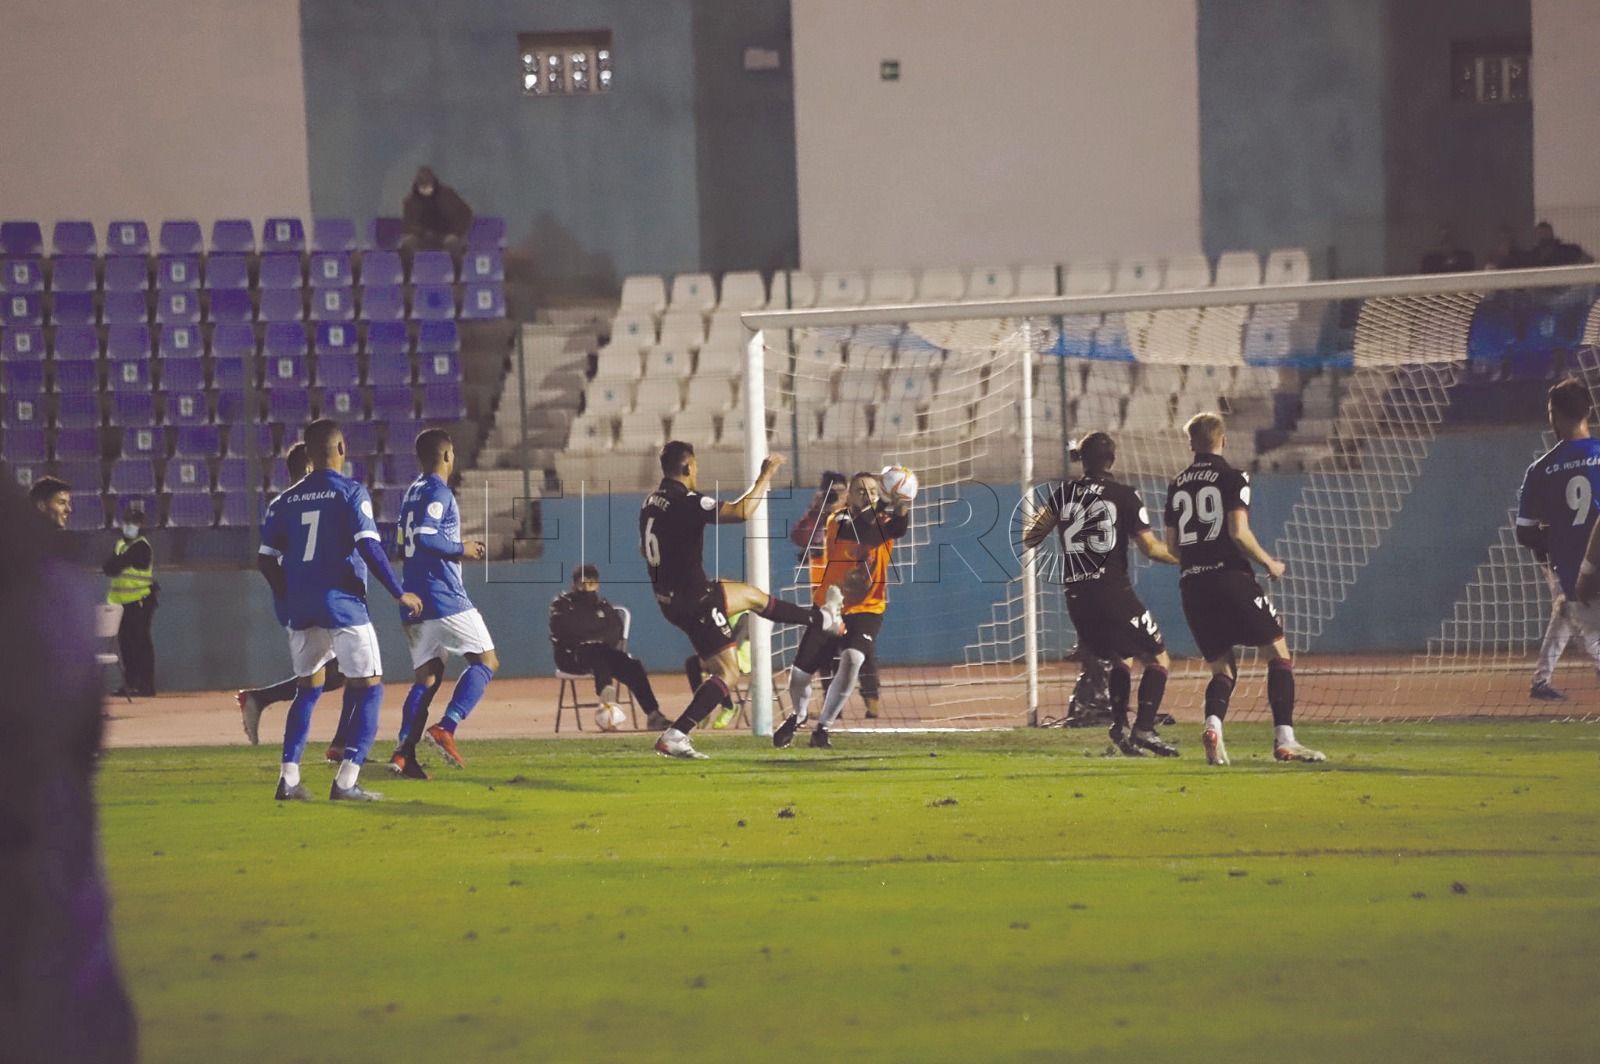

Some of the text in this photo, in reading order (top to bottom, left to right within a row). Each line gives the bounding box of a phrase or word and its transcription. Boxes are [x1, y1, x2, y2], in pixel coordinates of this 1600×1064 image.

[1176, 470, 1219, 487] CANTERO
[1563, 455, 1600, 470] HURACÁ
[1172, 486, 1224, 546] 29
[1566, 475, 1592, 526] 9
[301, 510, 320, 562] 7
[645, 517, 661, 568] 6
[1060, 500, 1118, 555] 23
[711, 607, 727, 627] 6
